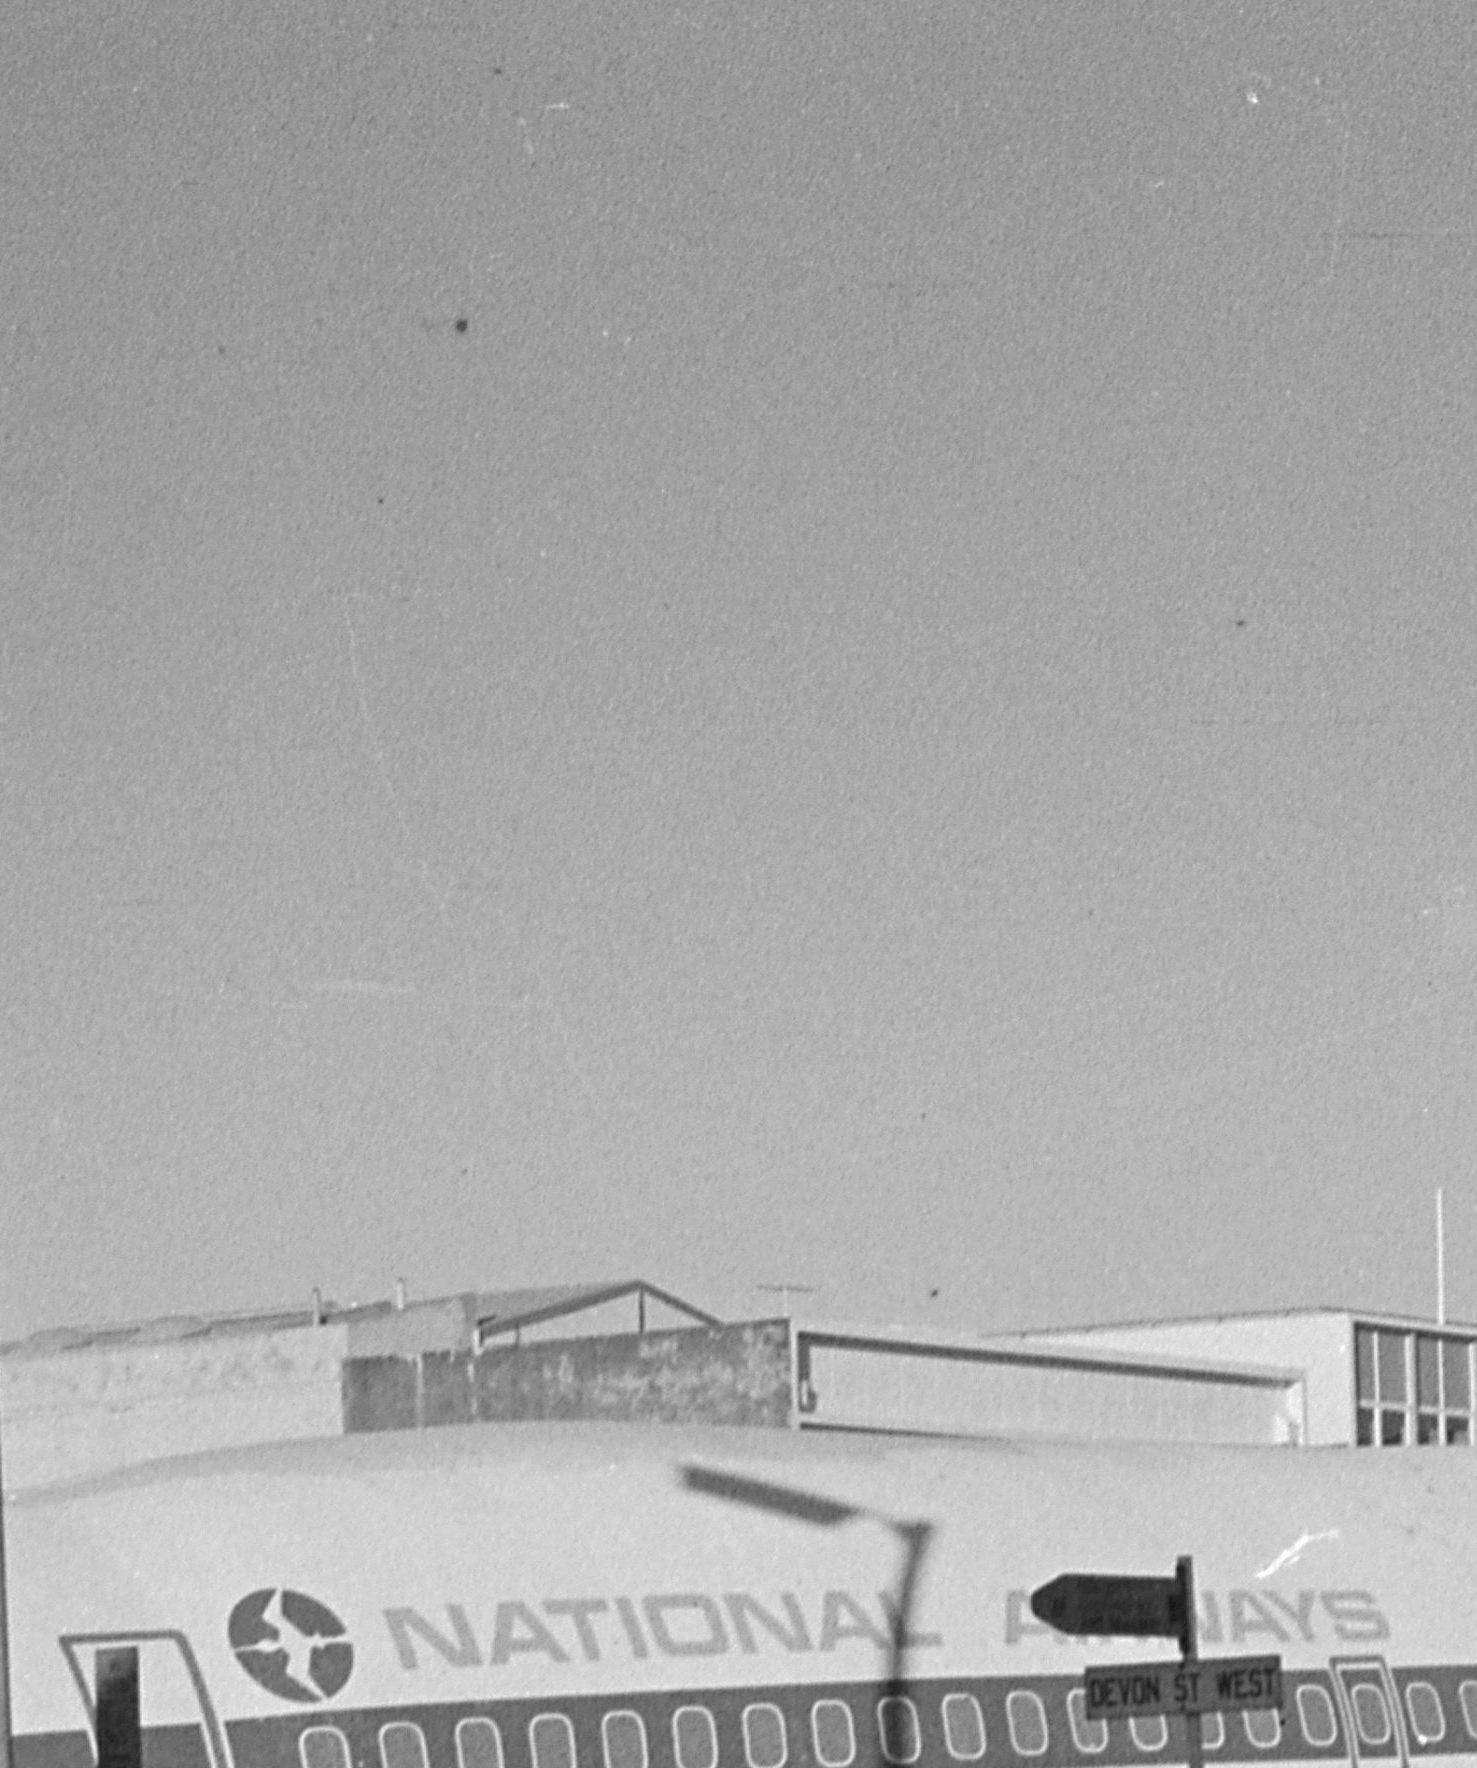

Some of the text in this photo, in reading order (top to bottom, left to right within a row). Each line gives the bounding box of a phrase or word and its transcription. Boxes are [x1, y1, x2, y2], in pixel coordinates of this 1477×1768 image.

[382, 1590, 944, 1670] NATIONAL
[1089, 1668, 1275, 1708] DEVON ST WEST
